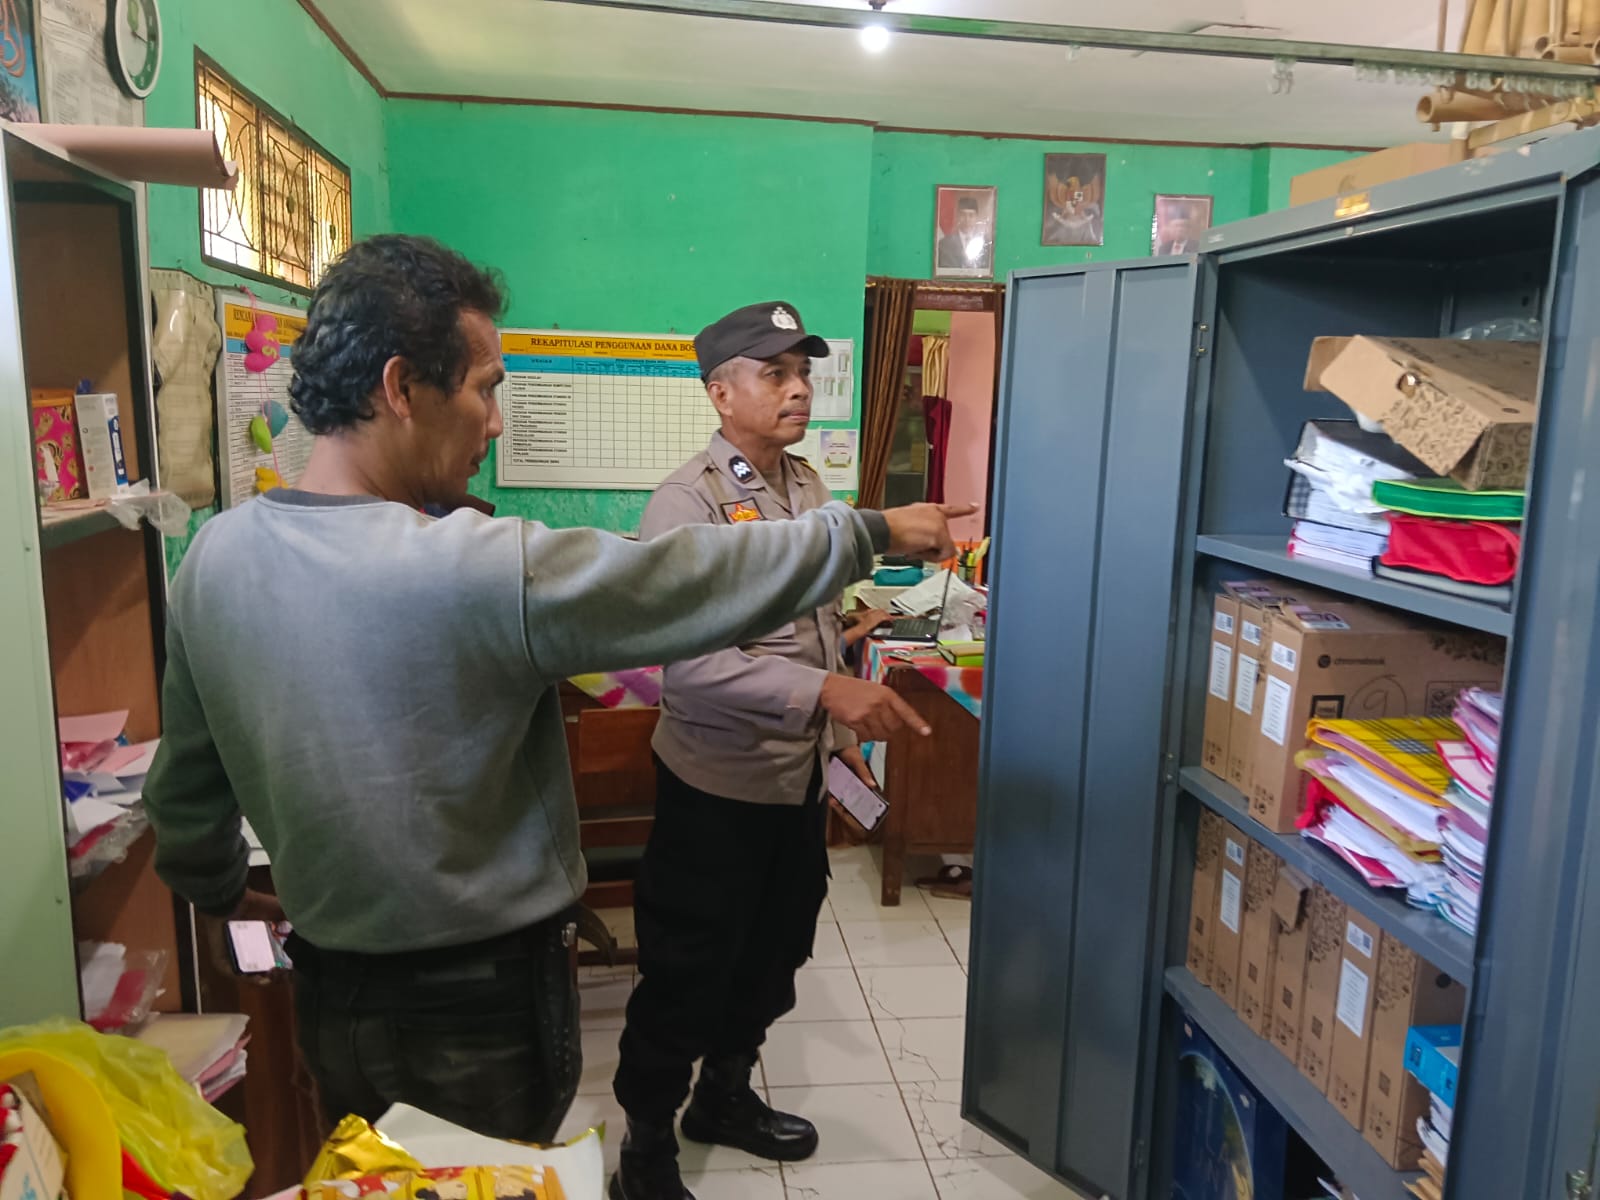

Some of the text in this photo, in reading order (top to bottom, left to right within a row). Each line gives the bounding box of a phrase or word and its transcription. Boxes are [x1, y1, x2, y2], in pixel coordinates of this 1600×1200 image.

[530, 337, 593, 348] REKAPITULASI
[595, 341, 652, 350] PENGGUNAAN
[654, 343, 678, 351] DANA
